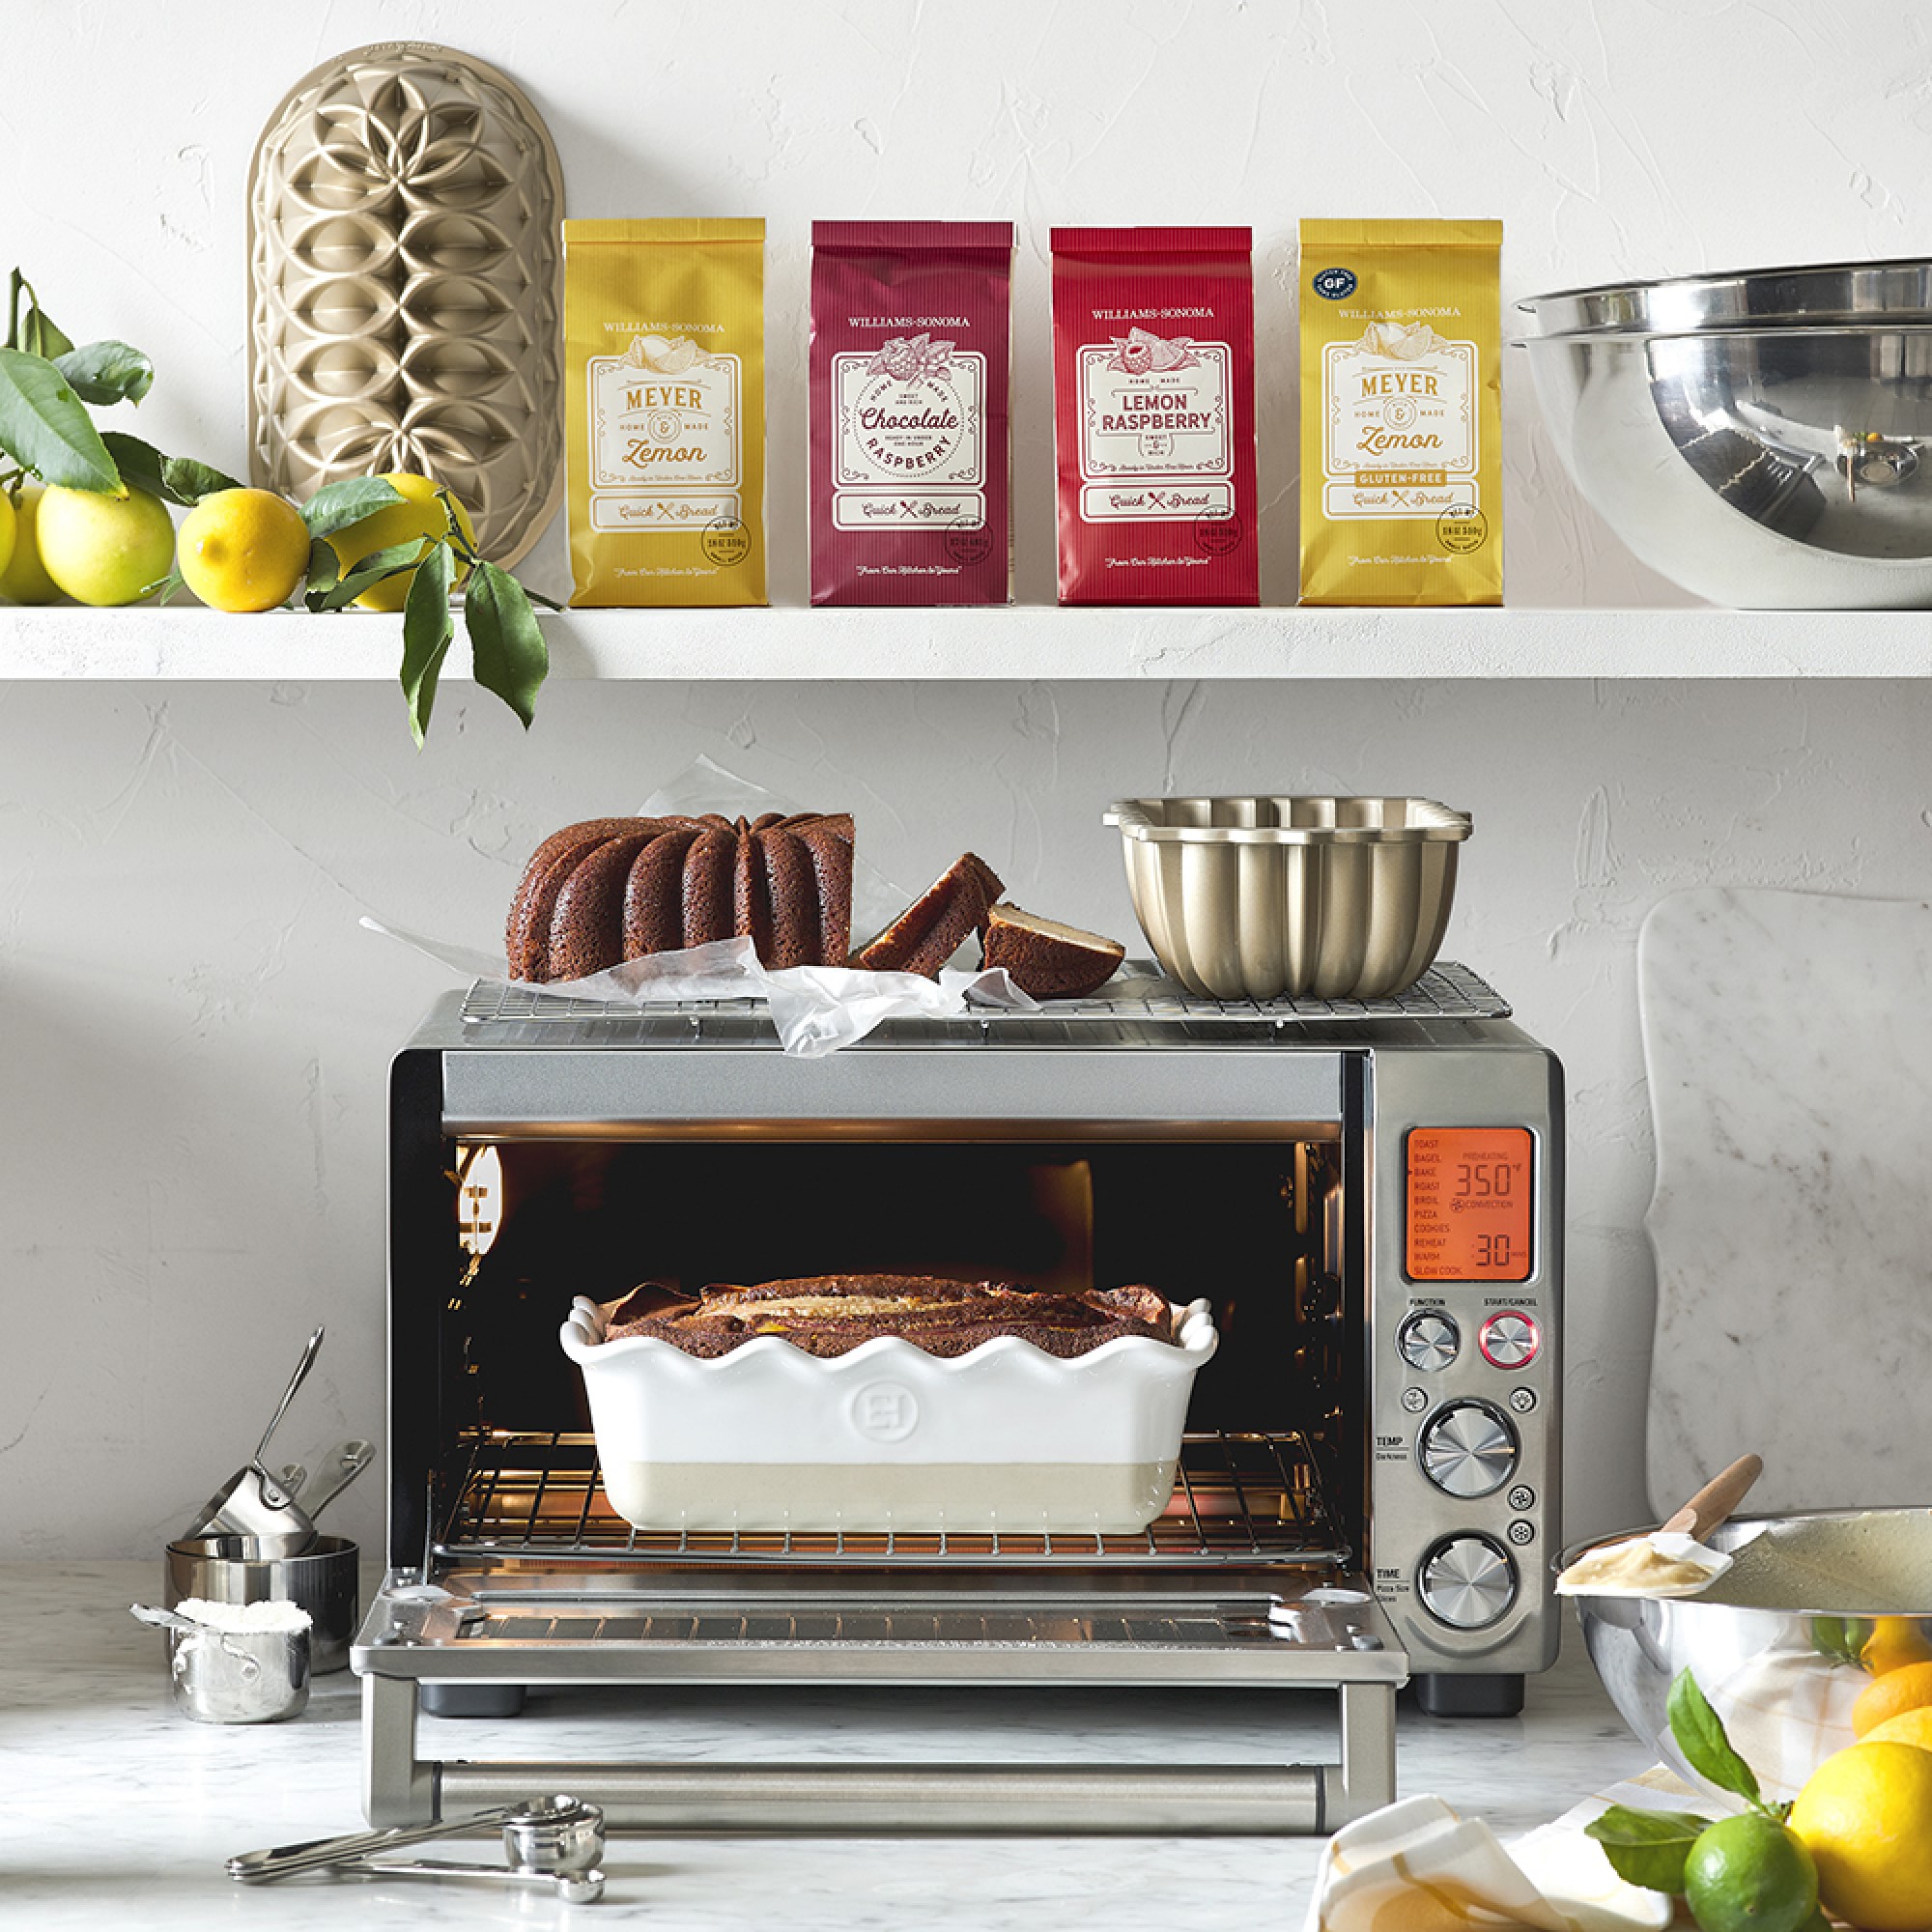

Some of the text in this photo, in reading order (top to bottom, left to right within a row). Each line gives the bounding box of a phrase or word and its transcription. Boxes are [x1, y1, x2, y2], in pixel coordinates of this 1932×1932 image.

[848, 317, 970, 327] WILLIAMS-SONOMA
[1092, 307, 1214, 320] WILLIAMS-SONOMA
[1361, 373, 1438, 397] MEYER
[626, 386, 702, 411] MEYER
[1122, 394, 1187, 411] LEMON
[860, 407, 958, 430] Chocolate
[1102, 412, 1211, 431] RASPBERRY
[1356, 426, 1443, 457] Lemon
[622, 439, 707, 469] Lemon
[867, 436, 951, 470] RASPBERRY
[1359, 472, 1443, 484] GLUTEN-FREE
[1109, 492, 1210, 510] Quick Bread
[1352, 491, 1454, 507] Quick Bread
[618, 501, 719, 520] Quick Bread
[862, 500, 961, 519] Quick Bread
[1476, 1235, 1510, 1266] 30
[1377, 1436, 1404, 1447] TEMP
[1377, 1568, 1400, 1578] TIME
